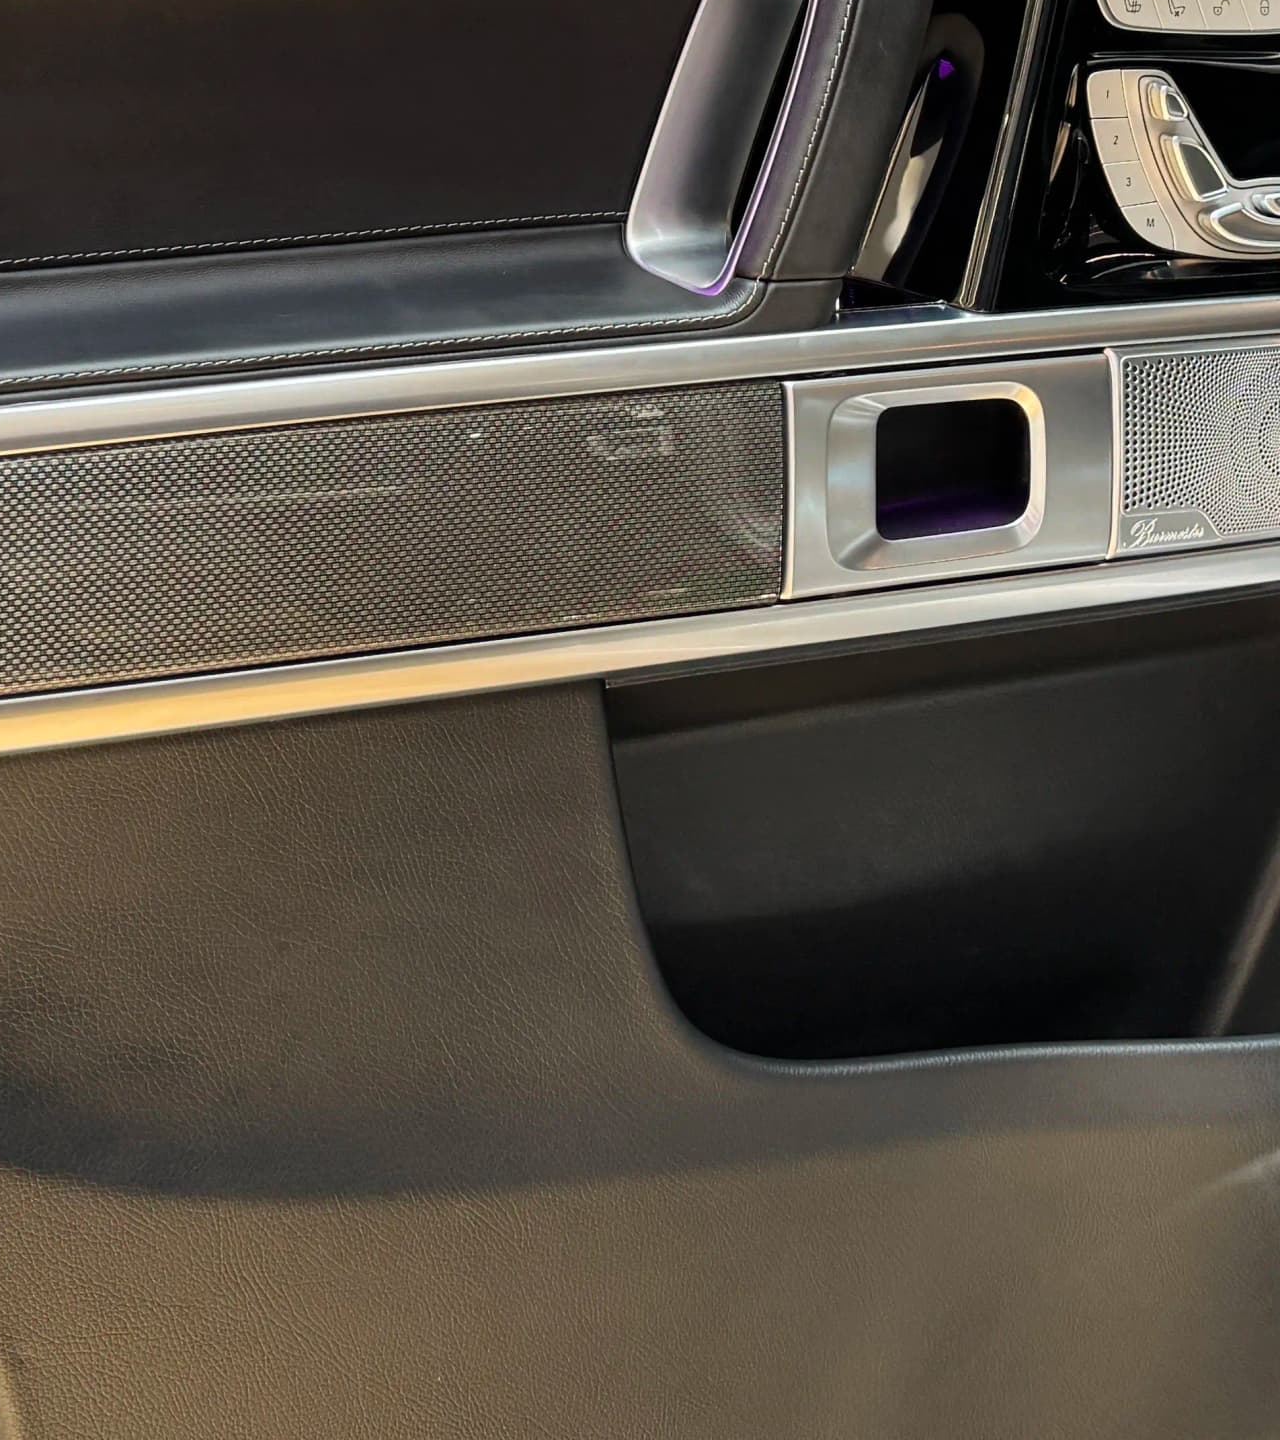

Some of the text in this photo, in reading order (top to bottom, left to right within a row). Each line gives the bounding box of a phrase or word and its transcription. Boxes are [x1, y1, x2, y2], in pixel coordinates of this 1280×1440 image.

[1113, 134, 1119, 145] 2
[1125, 176, 1132, 188] 3
[1146, 216, 1155, 228] M
